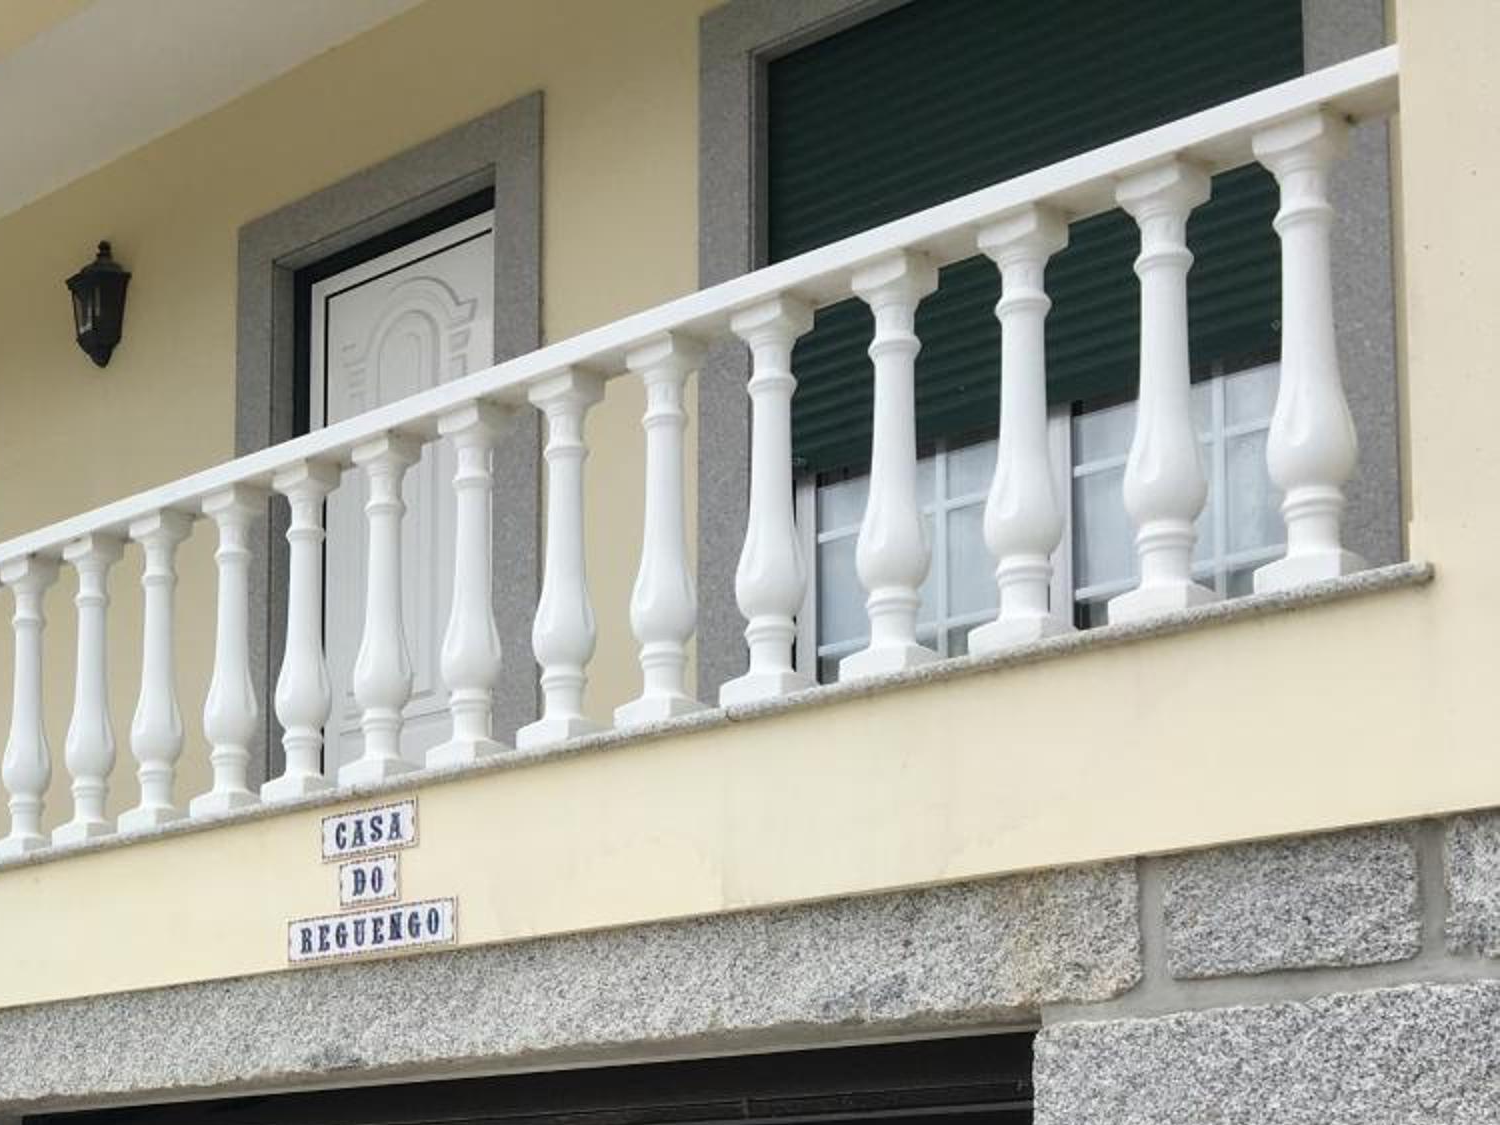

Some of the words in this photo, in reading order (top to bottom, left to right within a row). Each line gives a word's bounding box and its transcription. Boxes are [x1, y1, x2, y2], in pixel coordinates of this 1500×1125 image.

[335, 812, 403, 850] CASA
[352, 866, 383, 896] DO
[300, 907, 440, 954] REGUENGO
